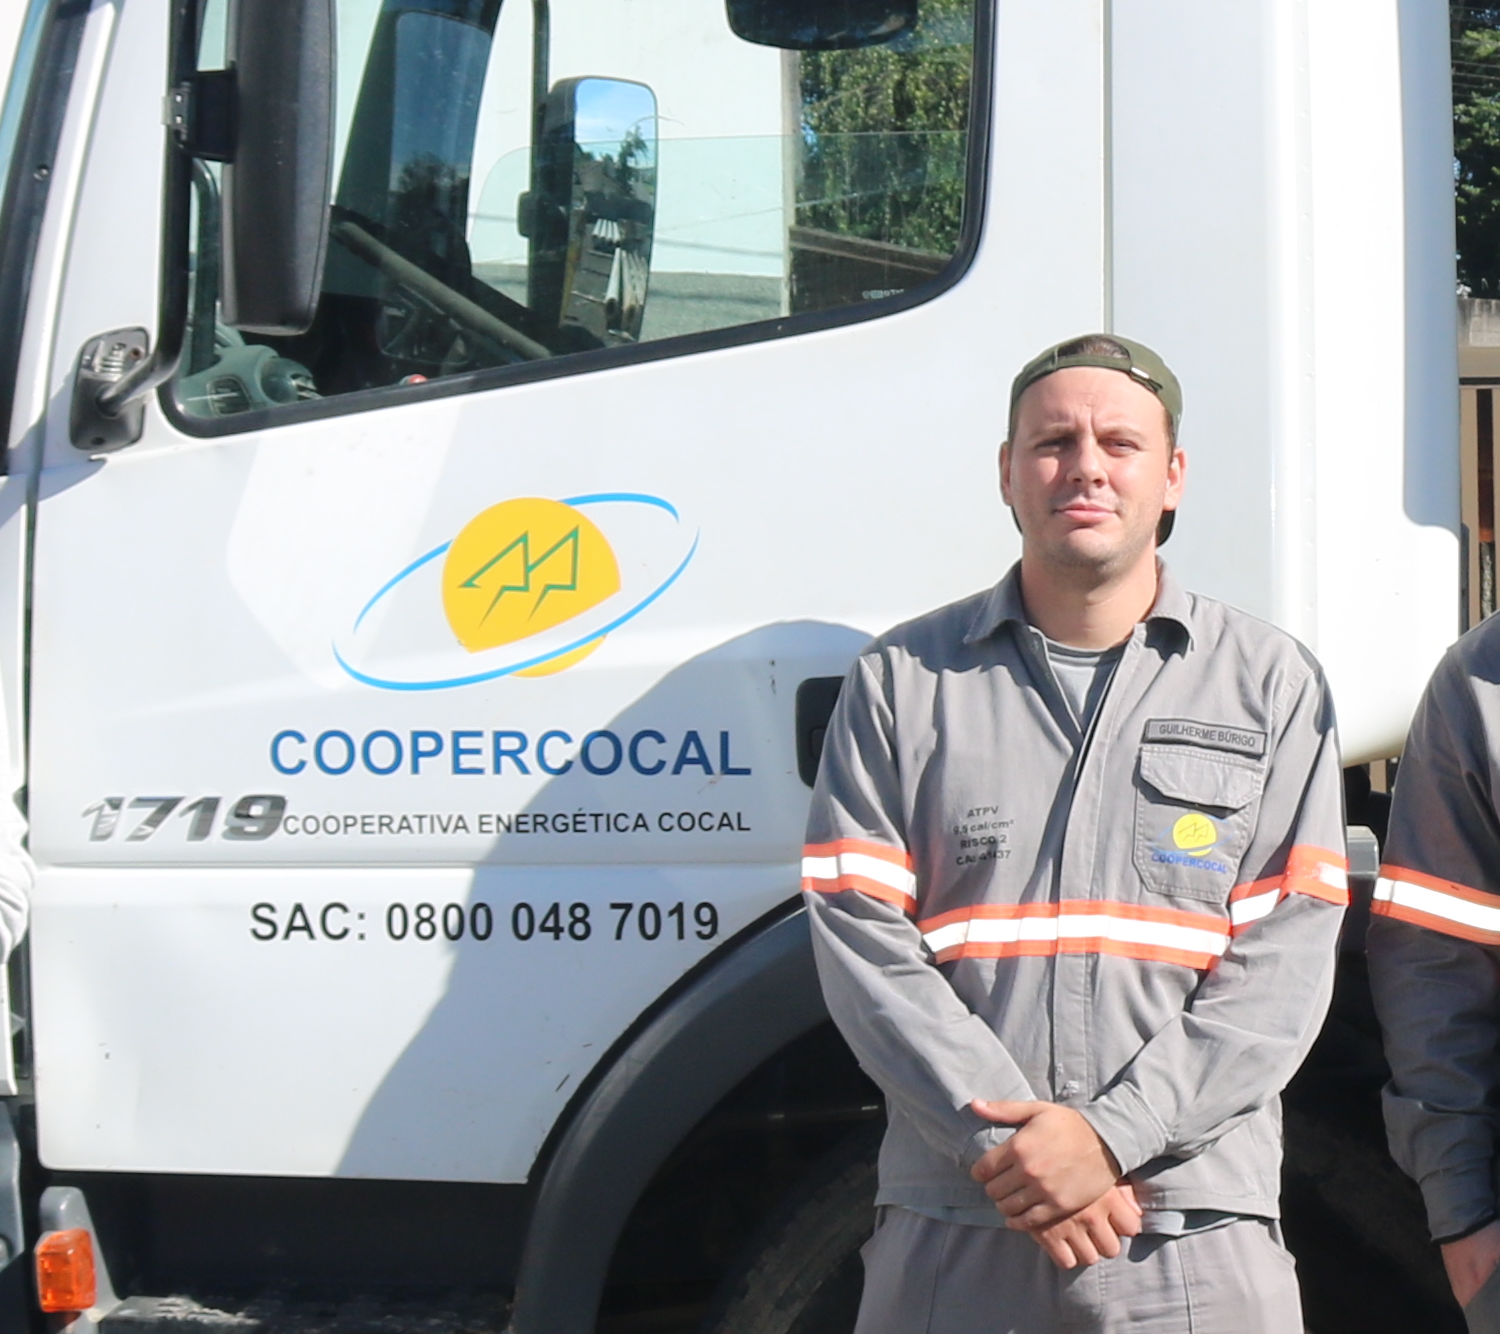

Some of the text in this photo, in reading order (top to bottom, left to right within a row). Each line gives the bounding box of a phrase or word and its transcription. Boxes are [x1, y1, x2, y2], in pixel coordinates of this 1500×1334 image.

[1159, 724, 1256, 747] GUILHERME BÚRIGO
[269, 728, 752, 777] COOPERCOCAL
[82, 793, 751, 843] 1719 COOPERATIVA ENERGÉTICA COCAL
[967, 806, 999, 818] ATPV
[960, 834, 1007, 849] RISCO 2
[1151, 852, 1227, 875] COOPERCOCAL
[249, 901, 720, 942] SAC: 0800 048 7019
